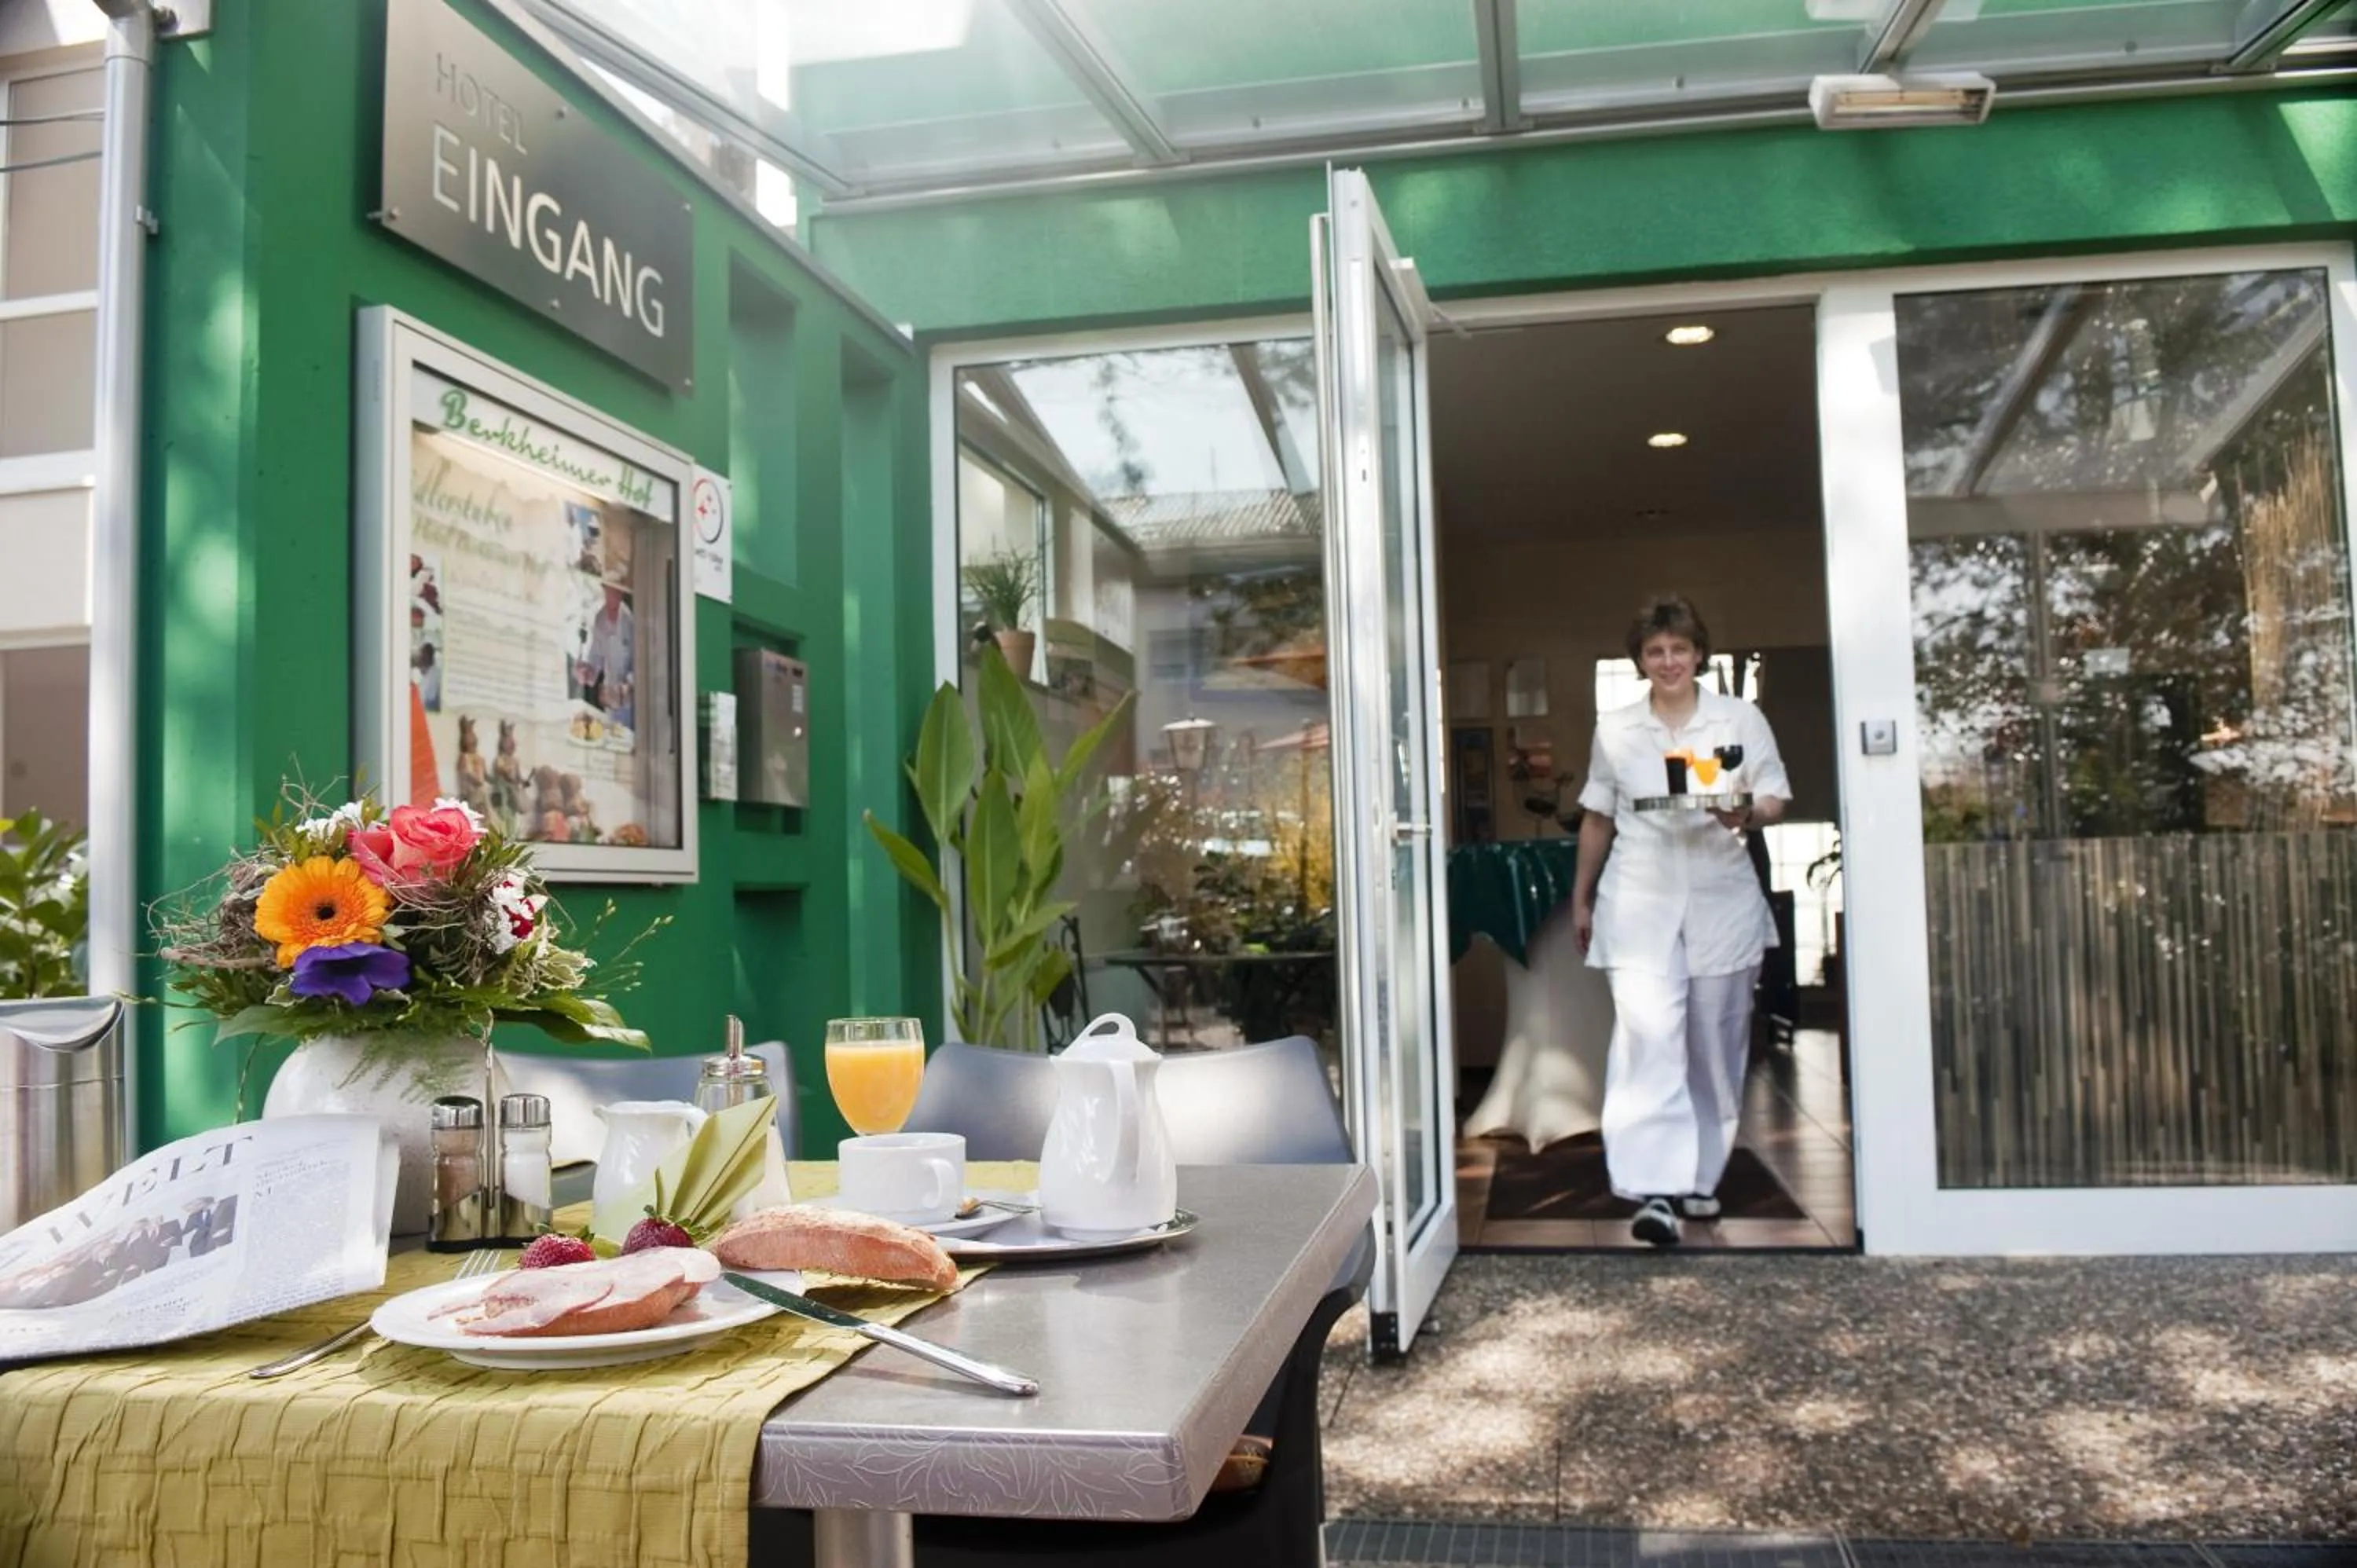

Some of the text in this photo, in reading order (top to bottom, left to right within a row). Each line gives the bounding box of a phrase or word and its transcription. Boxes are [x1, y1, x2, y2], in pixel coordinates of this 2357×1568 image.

[435, 52, 528, 156] HOTEL
[433, 122, 664, 337] EINGANG
[441, 389, 654, 510] Berkheimer Hof
